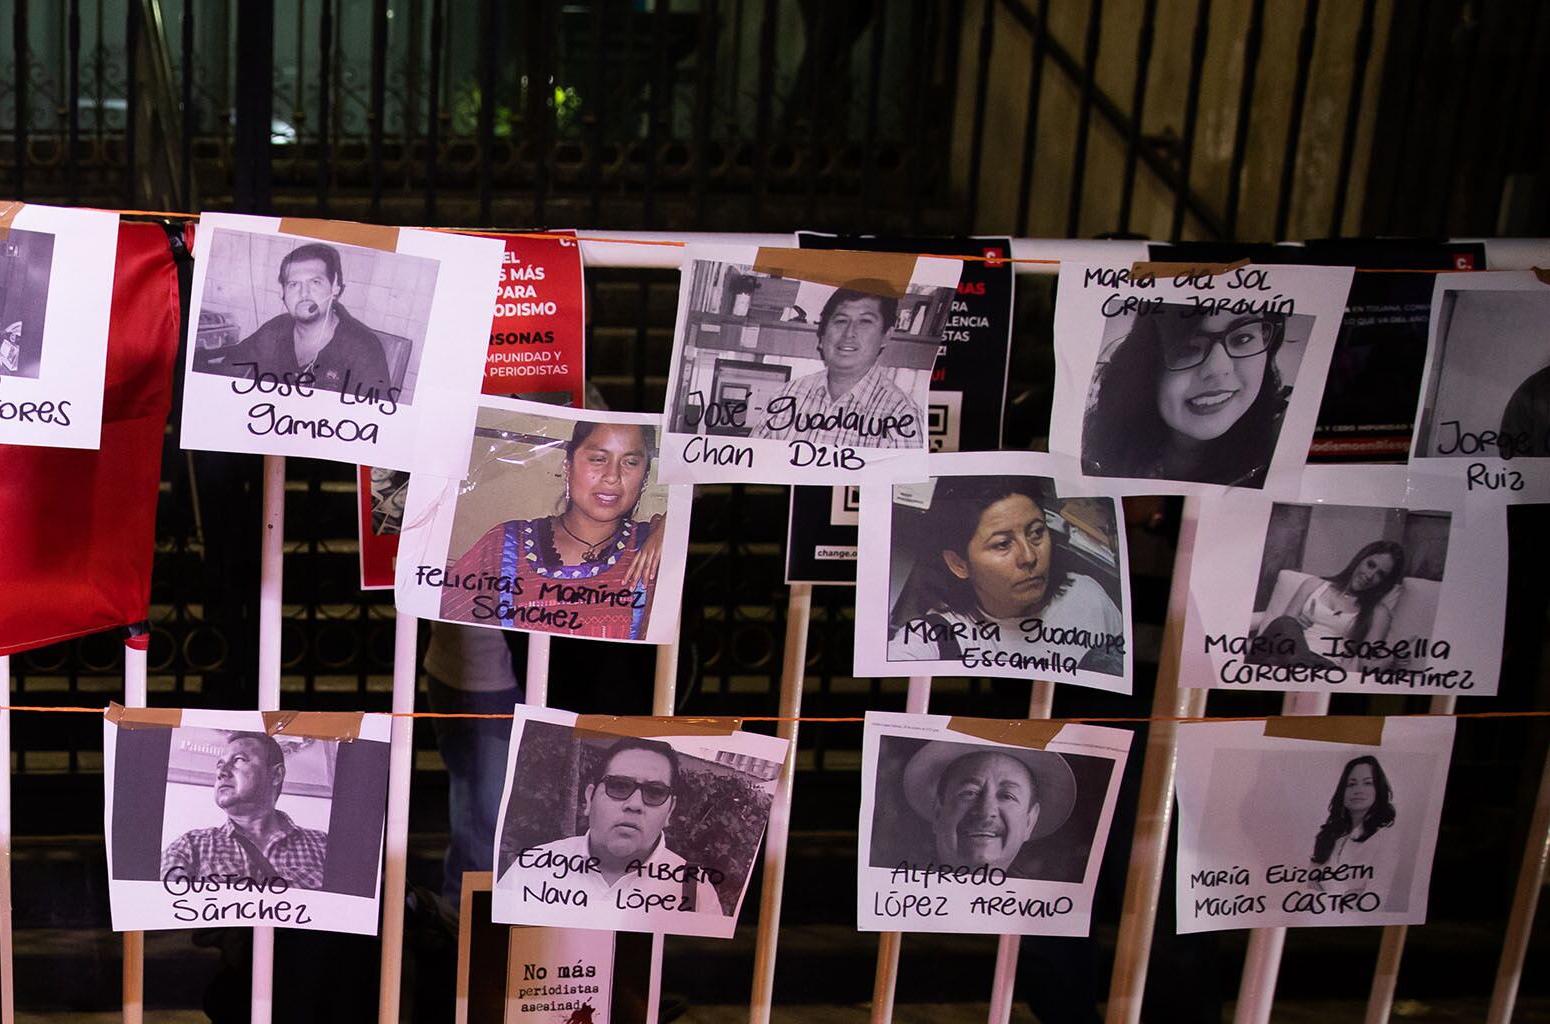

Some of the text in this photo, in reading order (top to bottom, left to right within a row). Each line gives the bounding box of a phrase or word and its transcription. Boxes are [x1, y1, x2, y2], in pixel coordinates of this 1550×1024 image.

[511, 264, 546, 281] MÁS
[494, 301, 557, 317] ODISMO
[485, 351, 562, 364] MPUNIDAD Y
[490, 364, 569, 378] PERIODISTAS
[339, 368, 402, 416] Luis
[682, 436, 754, 468] Chan
[1466, 463, 1525, 491] Ruiz
[817, 549, 857, 558] change.o
[958, 647, 1078, 677] Escamilla
[523, 881, 589, 908] Nava
[523, 959, 597, 981] No más
[518, 984, 599, 999] periodistas
